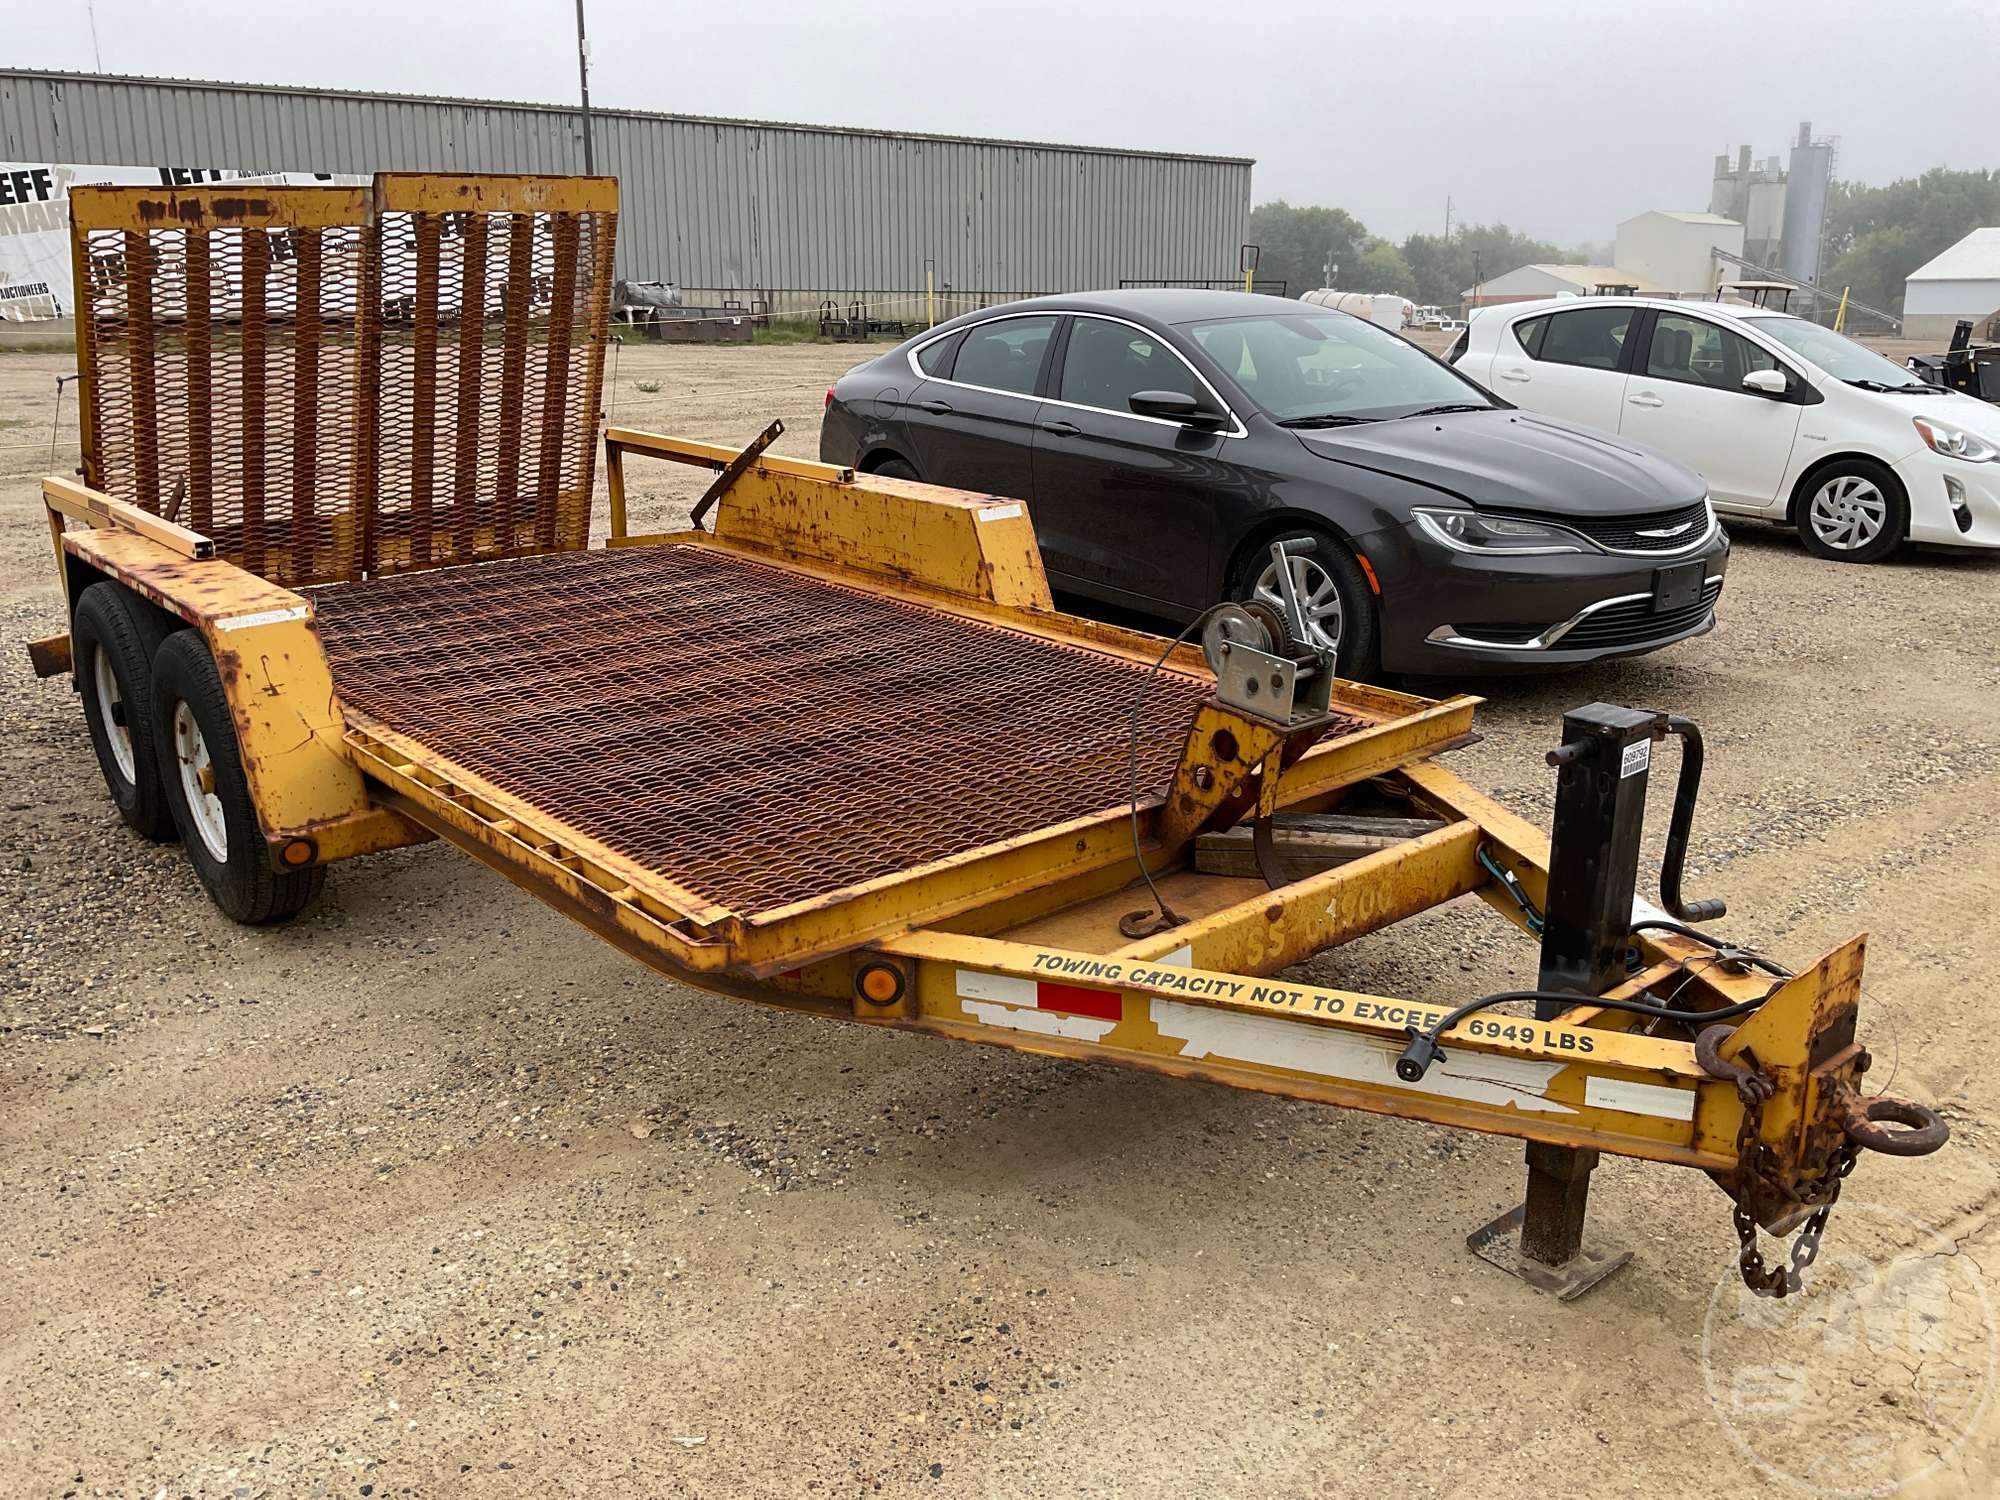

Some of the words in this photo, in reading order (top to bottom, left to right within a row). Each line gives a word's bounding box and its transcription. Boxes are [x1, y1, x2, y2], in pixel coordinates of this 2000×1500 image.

[0, 282, 49, 300] AUCTIONEERS
[1032, 954, 1122, 979] TOWING
[1129, 968, 1244, 998] CAPACITY
[1250, 986, 1303, 1008] NOT
[1312, 995, 1345, 1014] TO
[1353, 1002, 1457, 1031] EXCEE
[1469, 1019, 1535, 1044] 6949
[1543, 1030, 1594, 1053] LBS
